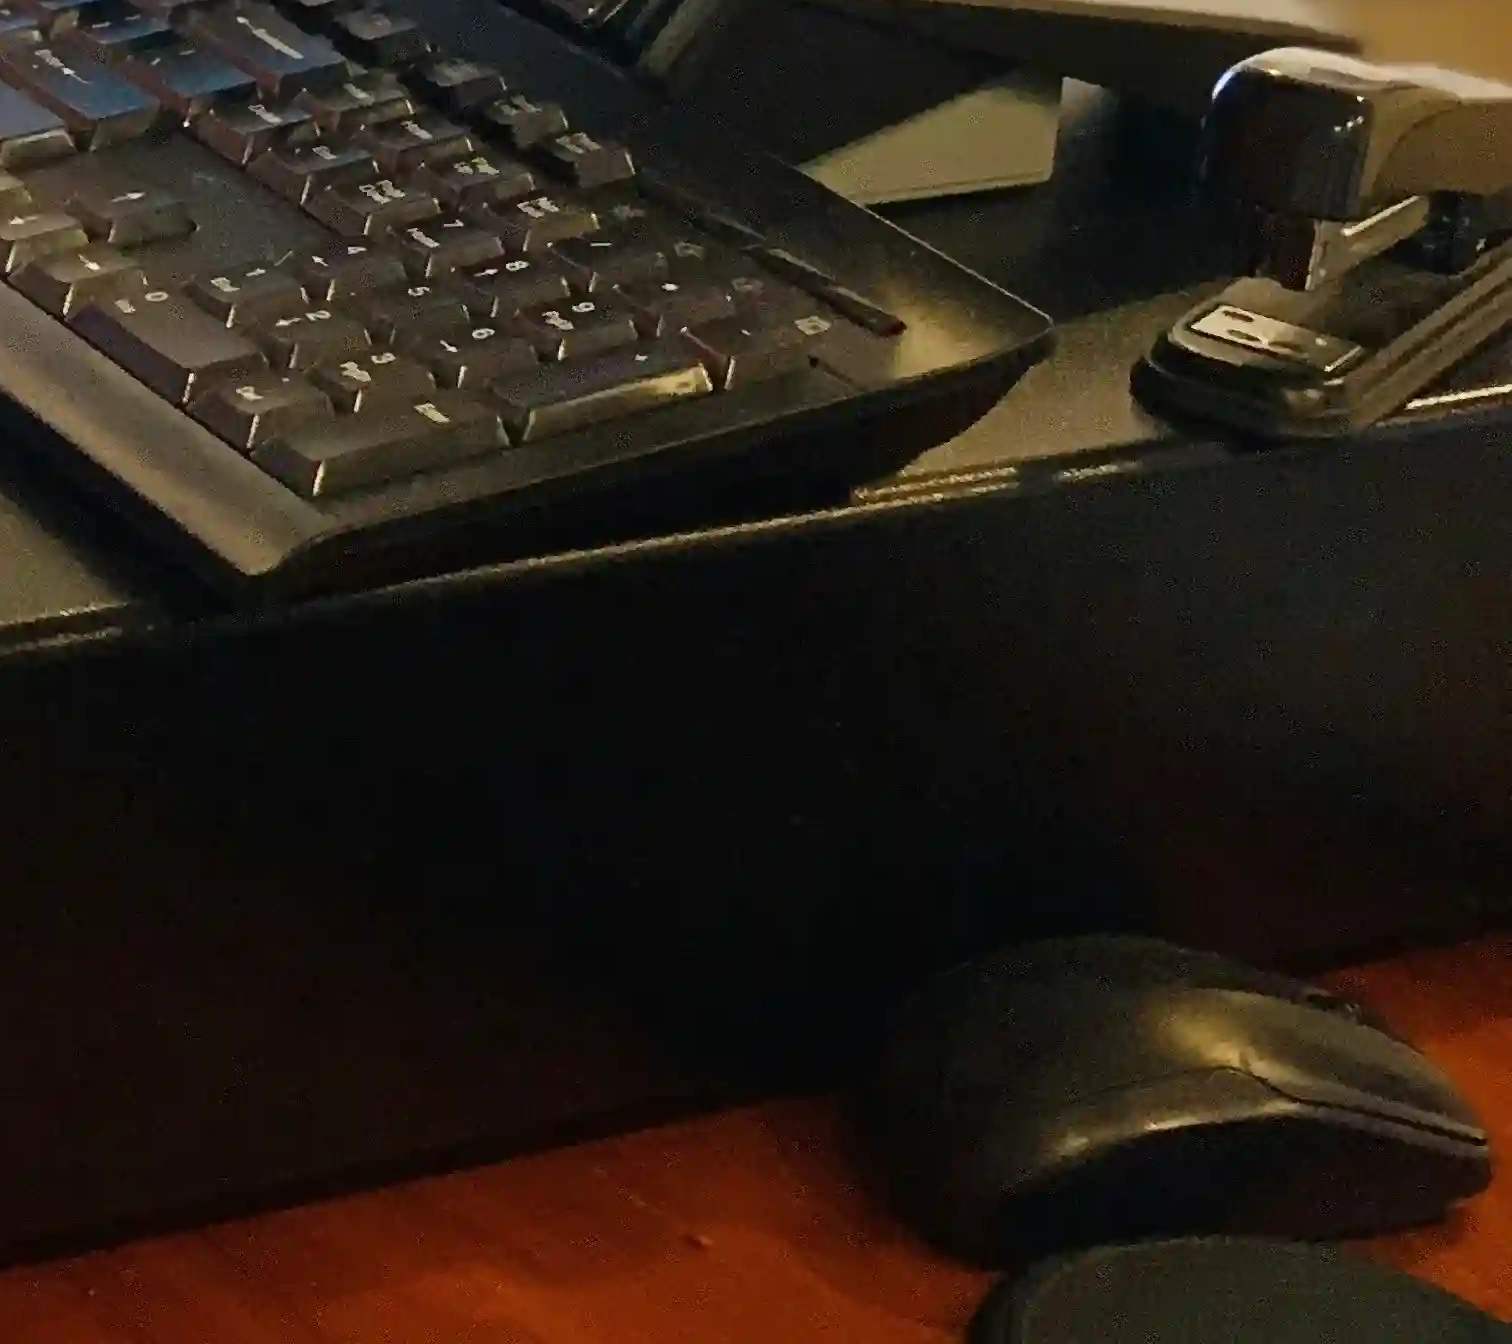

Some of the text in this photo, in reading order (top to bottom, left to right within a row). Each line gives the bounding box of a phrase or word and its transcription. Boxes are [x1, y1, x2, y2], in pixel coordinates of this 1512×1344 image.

[505, 259, 530, 272] 8
[144, 290, 170, 303] 0
[407, 285, 432, 298] 5
[571, 301, 596, 313] 9
[304, 309, 332, 322] 2
[471, 327, 496, 340] 6
[370, 351, 397, 365] 3
